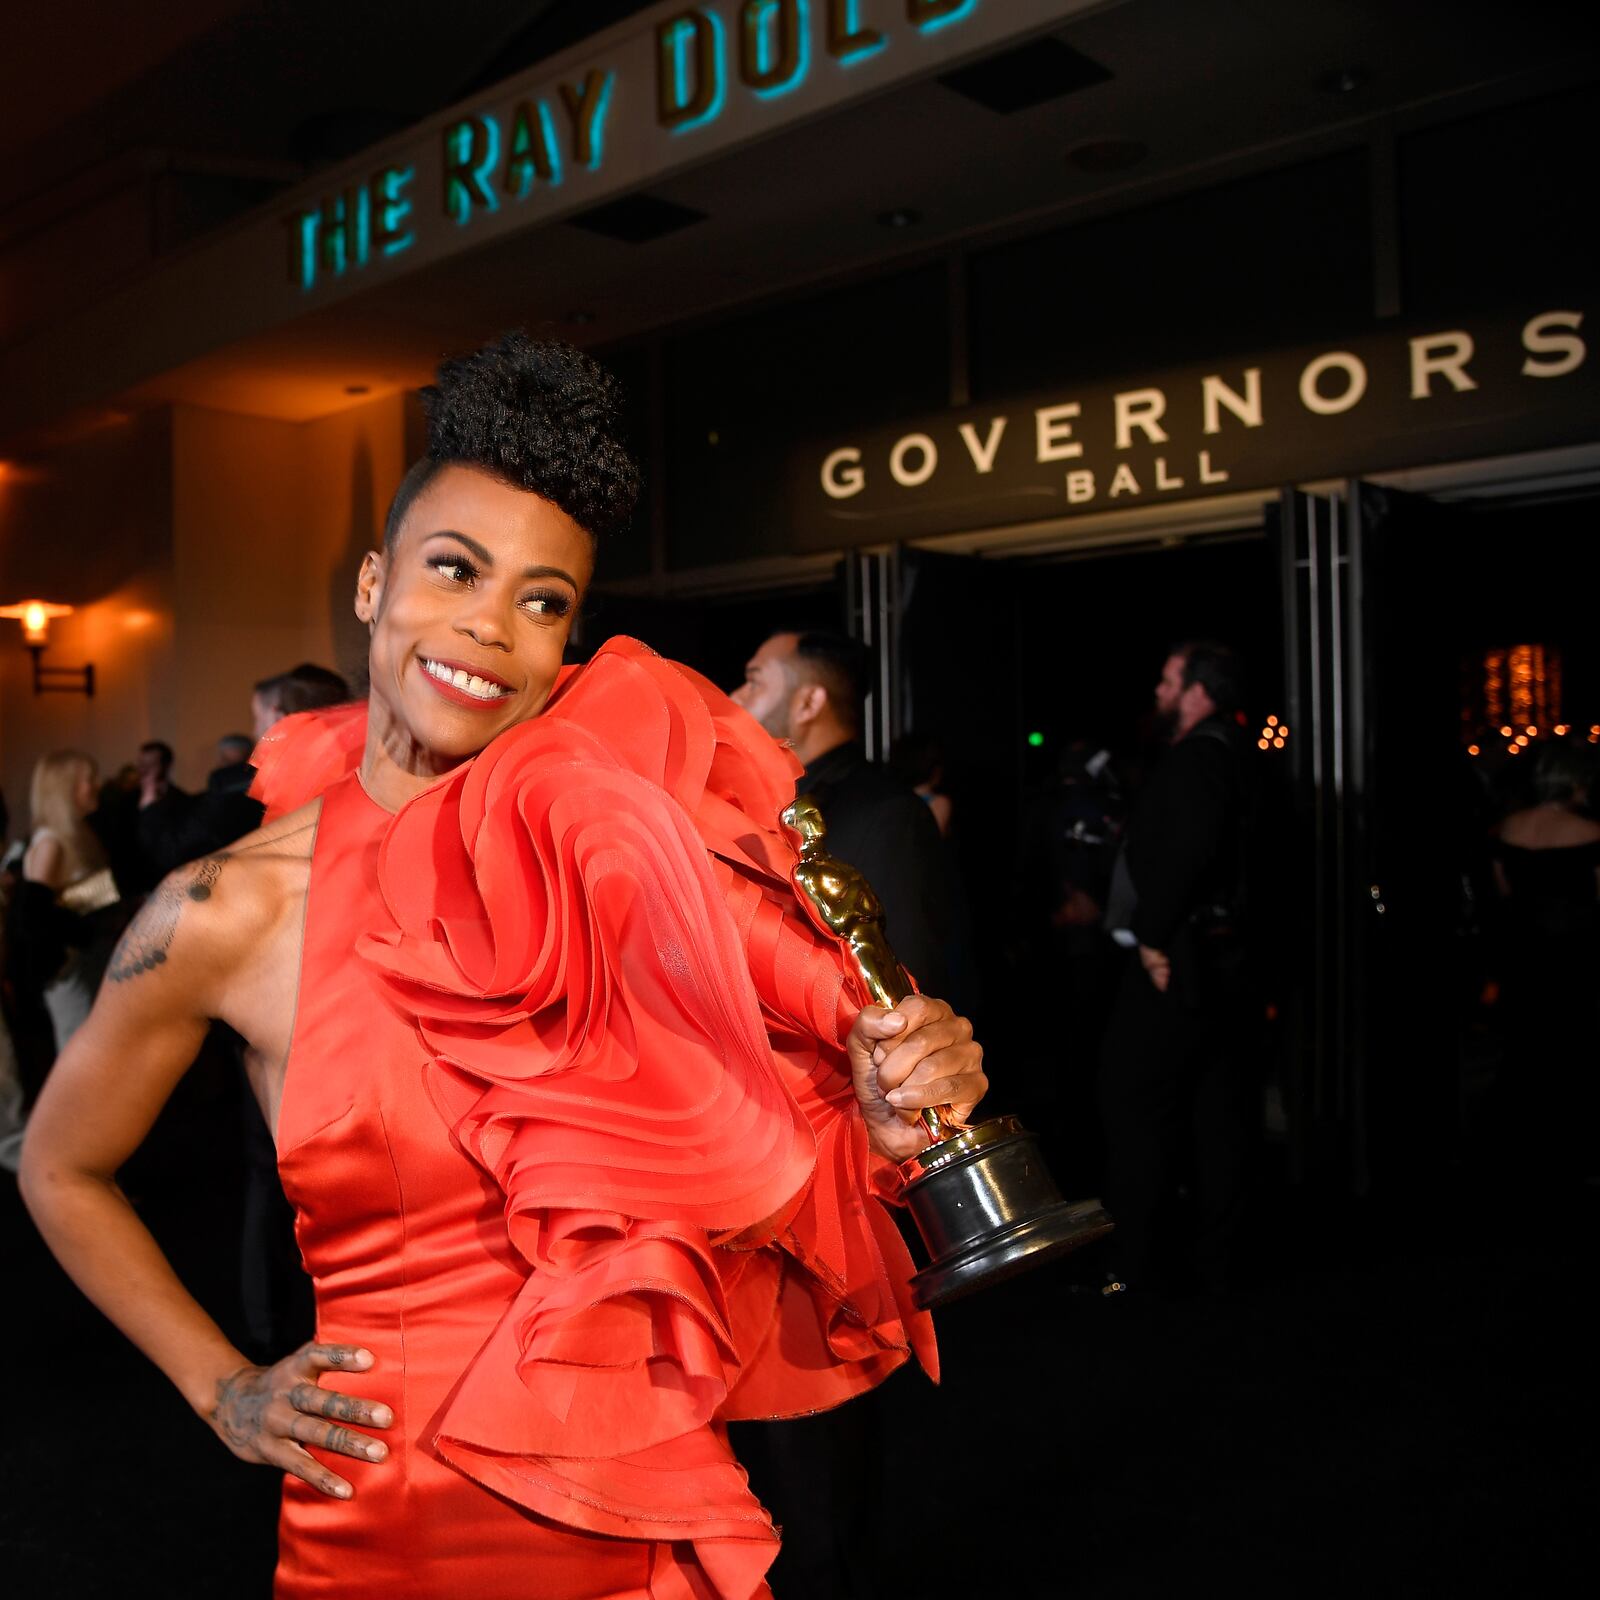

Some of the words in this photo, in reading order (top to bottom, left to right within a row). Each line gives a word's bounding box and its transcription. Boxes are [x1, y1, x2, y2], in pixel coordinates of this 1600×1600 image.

[283, 163, 415, 291] THE
[443, 70, 615, 224] RAY
[656, 0, 978, 134] DOL
[820, 311, 1586, 499] GOVERNORS
[1065, 451, 1229, 503] BALL
